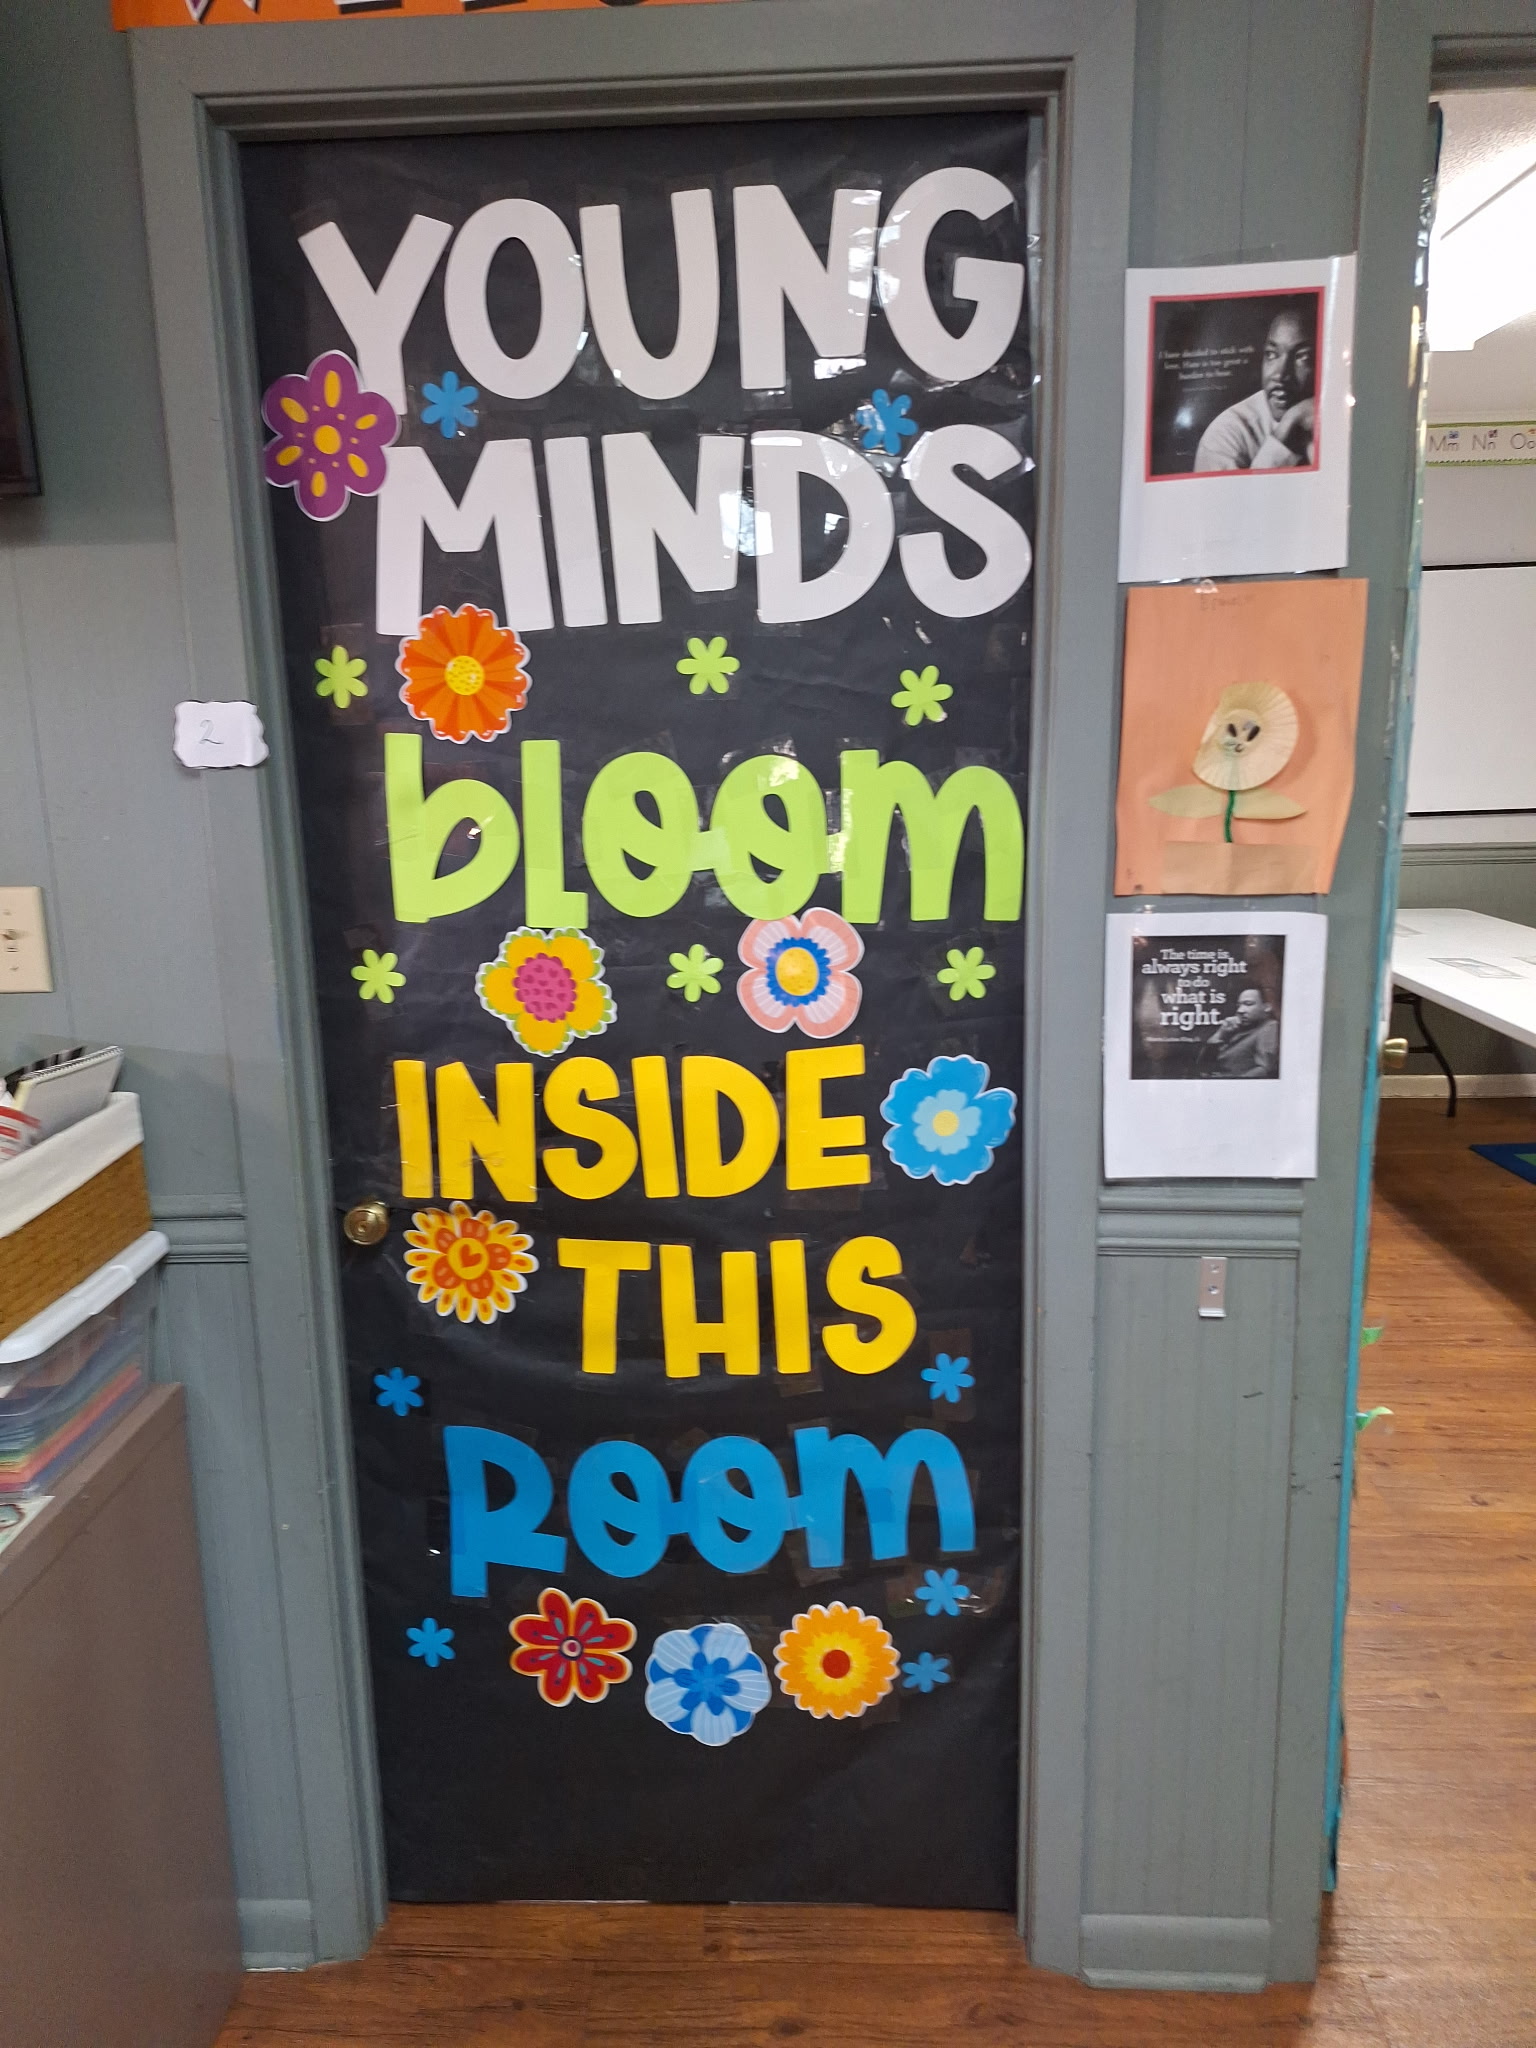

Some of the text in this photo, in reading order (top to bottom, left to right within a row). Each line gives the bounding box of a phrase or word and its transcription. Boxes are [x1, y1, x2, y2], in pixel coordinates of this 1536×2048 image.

[298, 167, 1023, 414] YOUNG
[1429, 434, 1459, 452] Mm
[1471, 433, 1496, 451] Nn
[376, 424, 1032, 635] MINDS
[199, 719, 224, 745] 2
[1160, 948, 1230, 960] The time is
[1141, 957, 1248, 977] always right
[1177, 976, 1211, 988] to do
[1160, 986, 1226, 1004] what is
[394, 1044, 871, 1202] INSIDE
[557, 1235, 917, 1378] THIS
